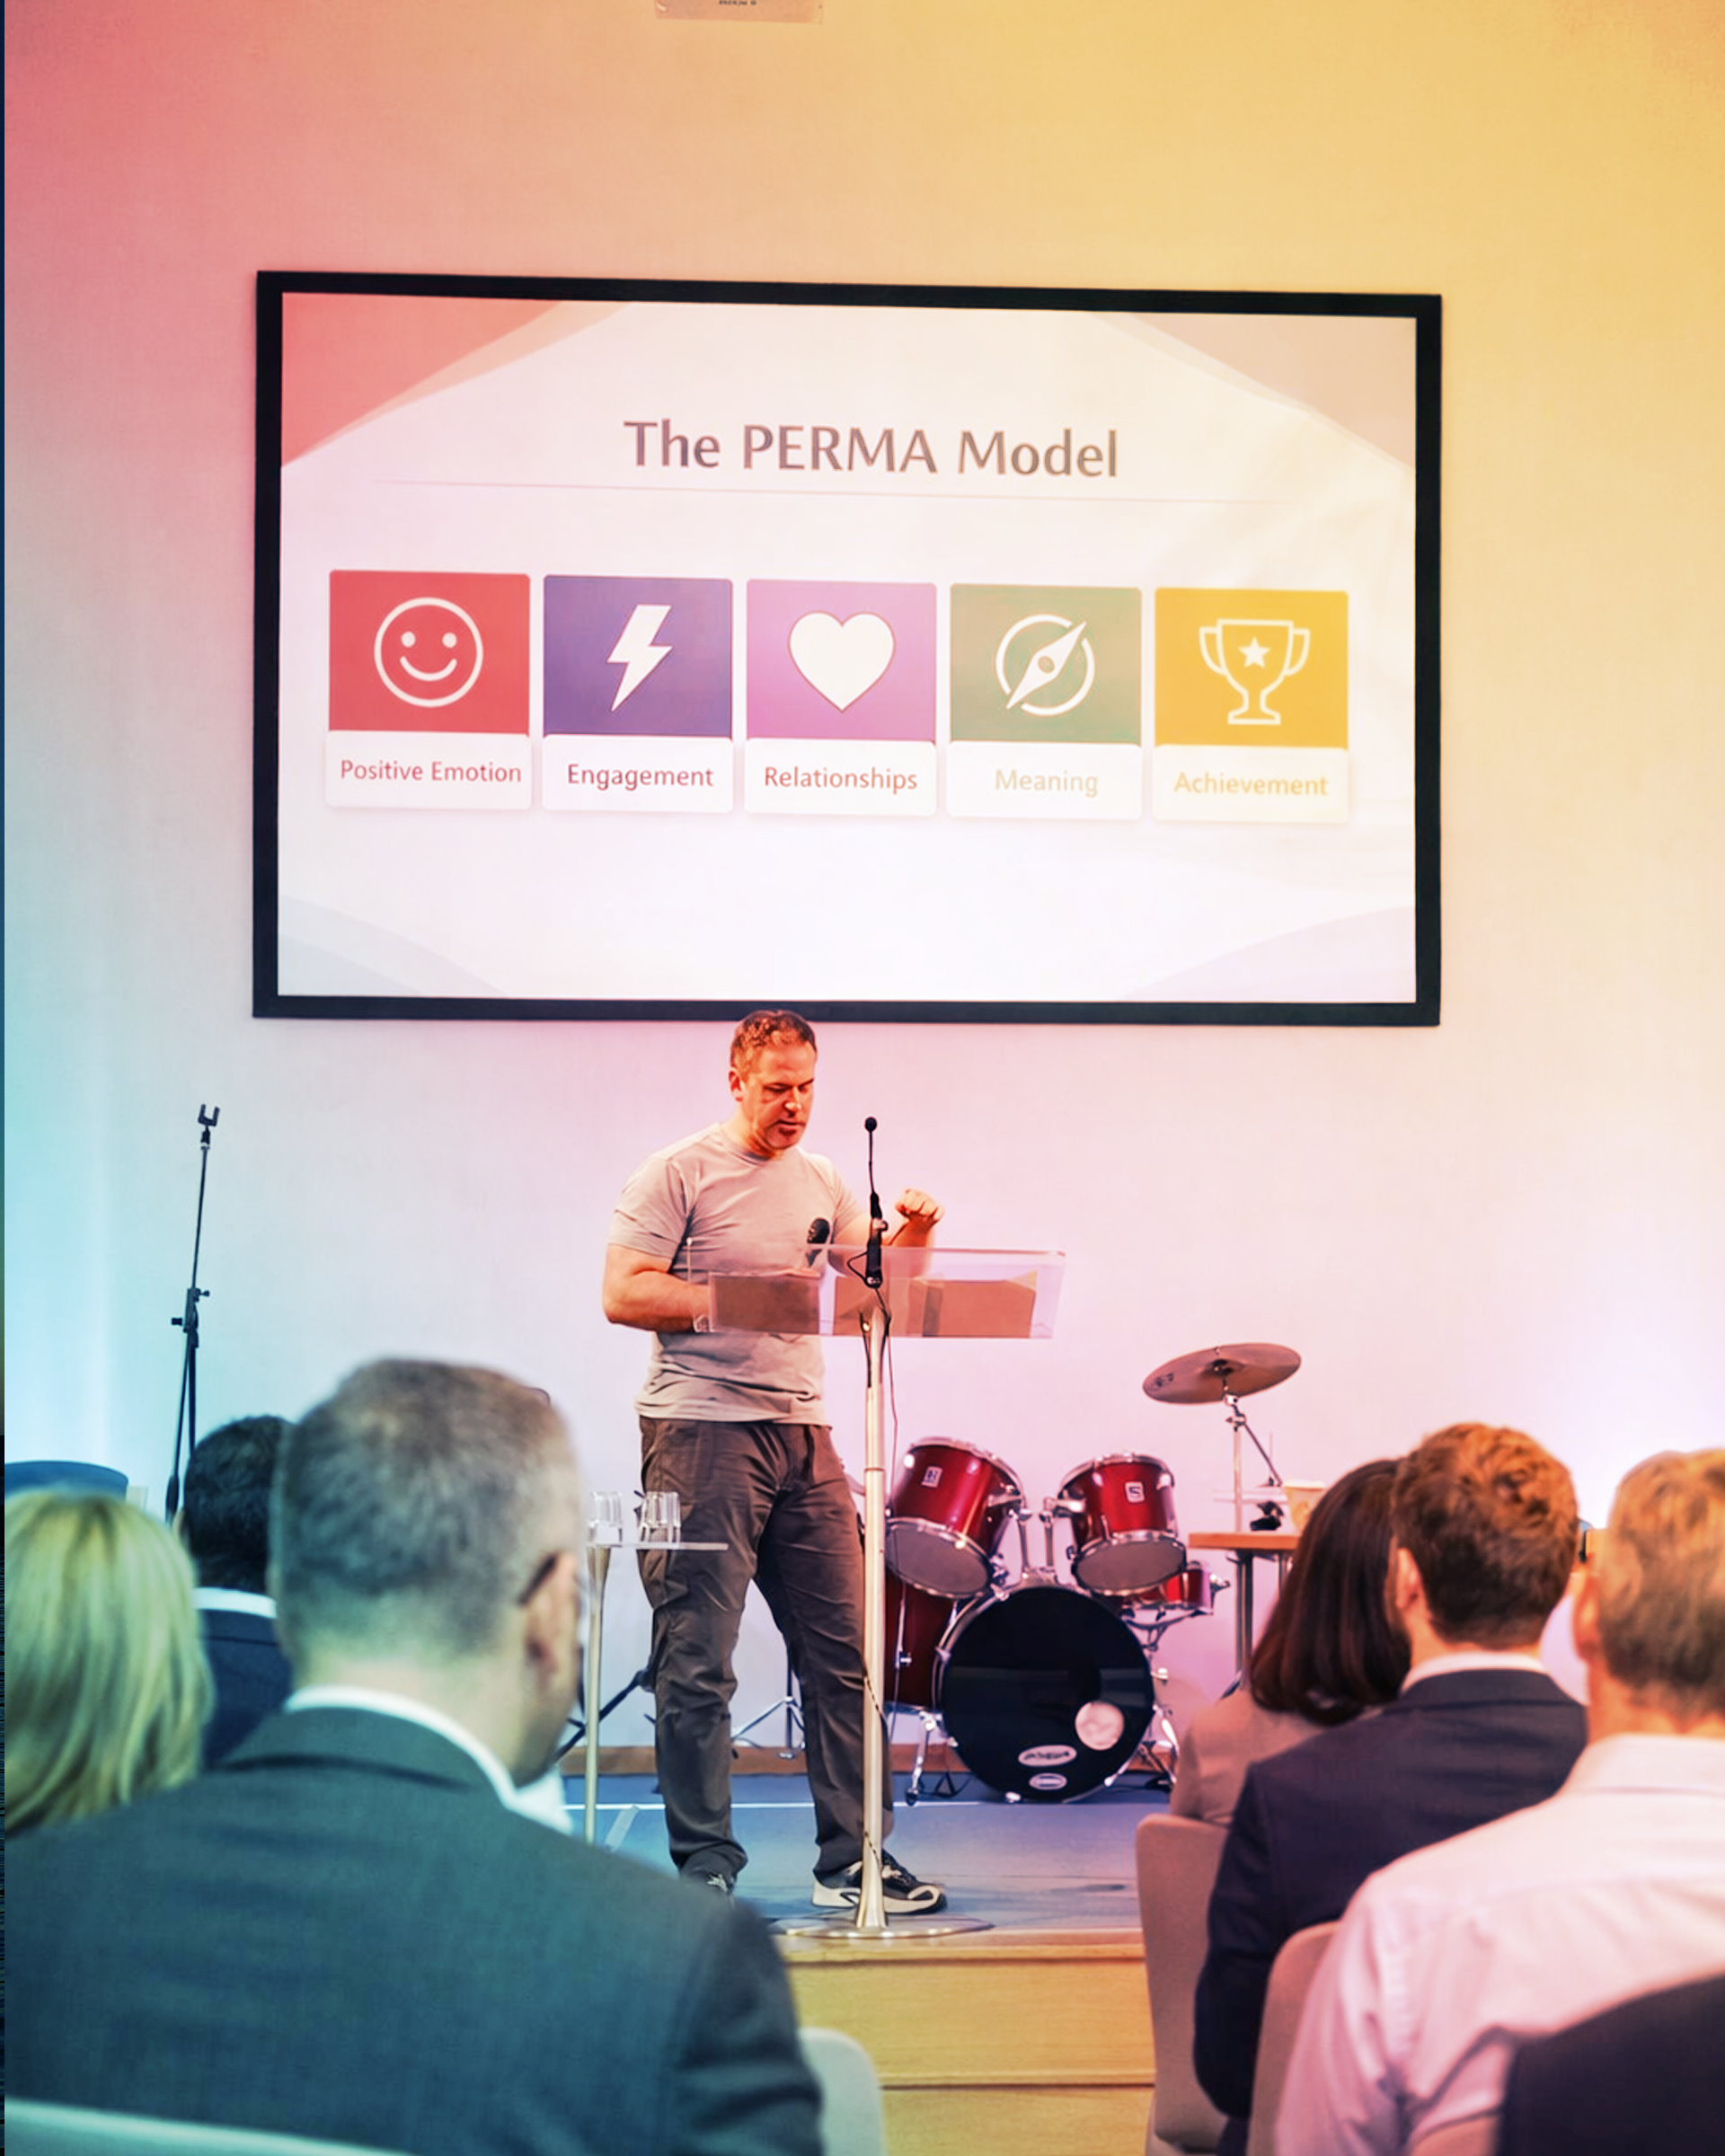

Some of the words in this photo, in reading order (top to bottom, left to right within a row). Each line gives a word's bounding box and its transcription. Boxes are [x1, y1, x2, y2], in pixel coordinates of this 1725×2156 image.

[624, 418, 721, 468] The
[742, 424, 939, 474] PERMA
[957, 427, 1118, 479] Model
[341, 759, 424, 782] Positive
[431, 760, 522, 783] Emotion
[567, 764, 714, 791] Engagement
[764, 765, 918, 795] Relationships
[995, 768, 1099, 798] Meaning
[1173, 771, 1330, 797] Achievement
